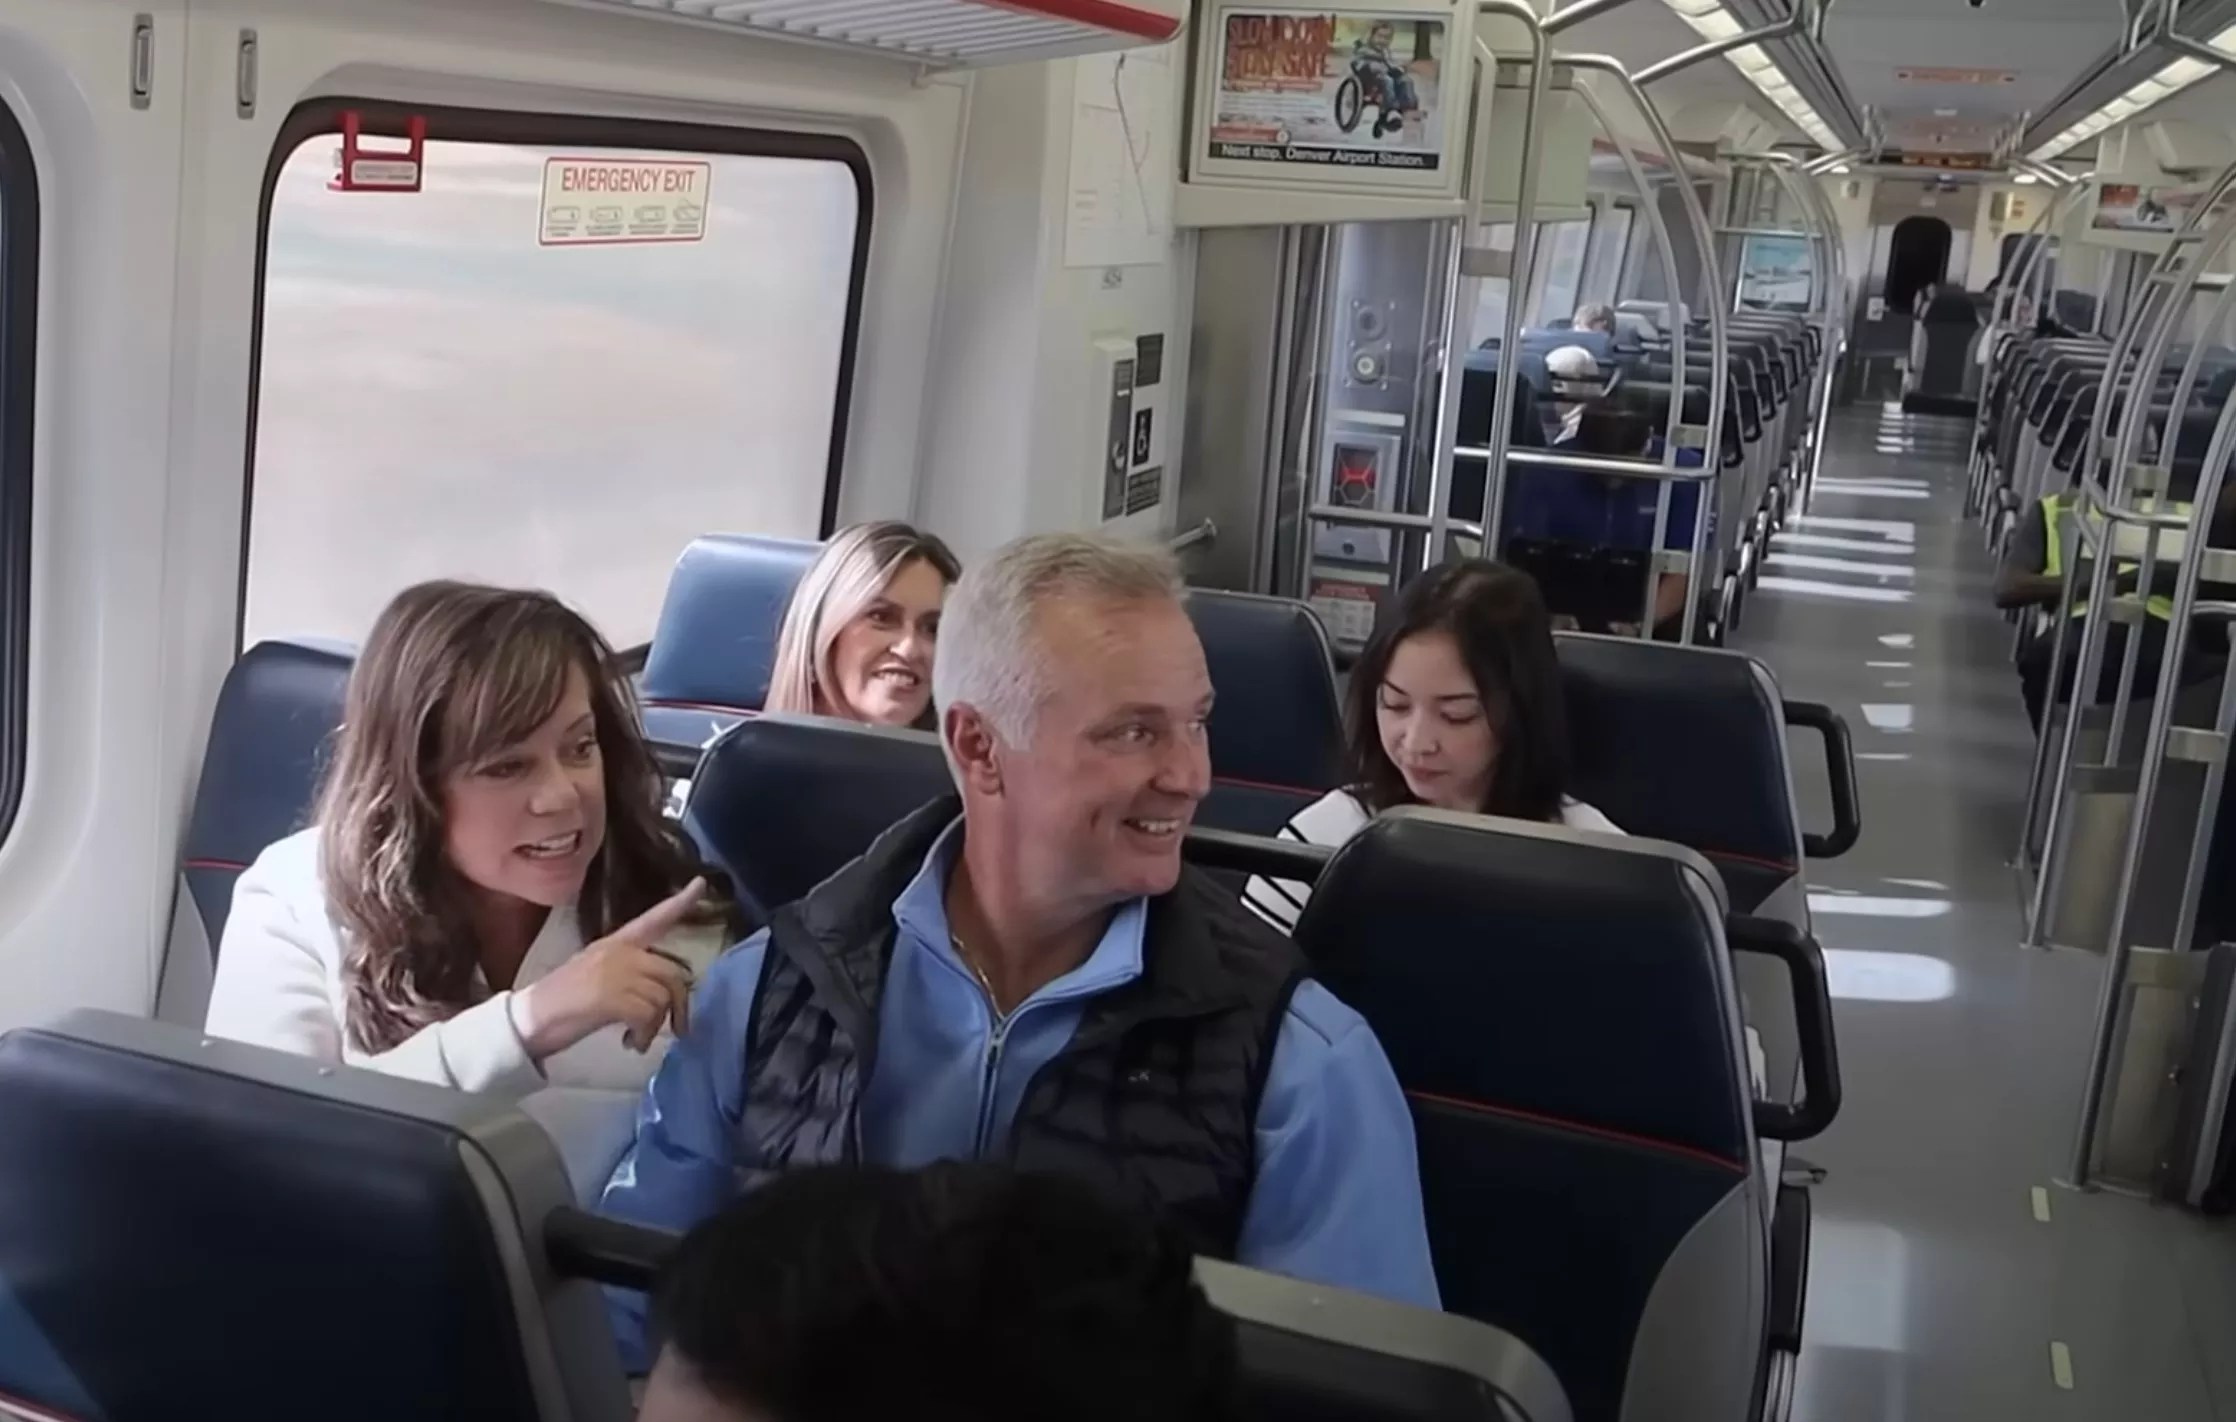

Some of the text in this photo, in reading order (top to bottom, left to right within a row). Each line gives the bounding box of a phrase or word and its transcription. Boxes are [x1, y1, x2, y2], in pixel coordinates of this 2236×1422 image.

[1222, 144, 1251, 157] Next
[1286, 147, 1331, 162] Denver
[1333, 150, 1376, 165] Airport
[562, 167, 696, 192] EMERGENCY EXIT
